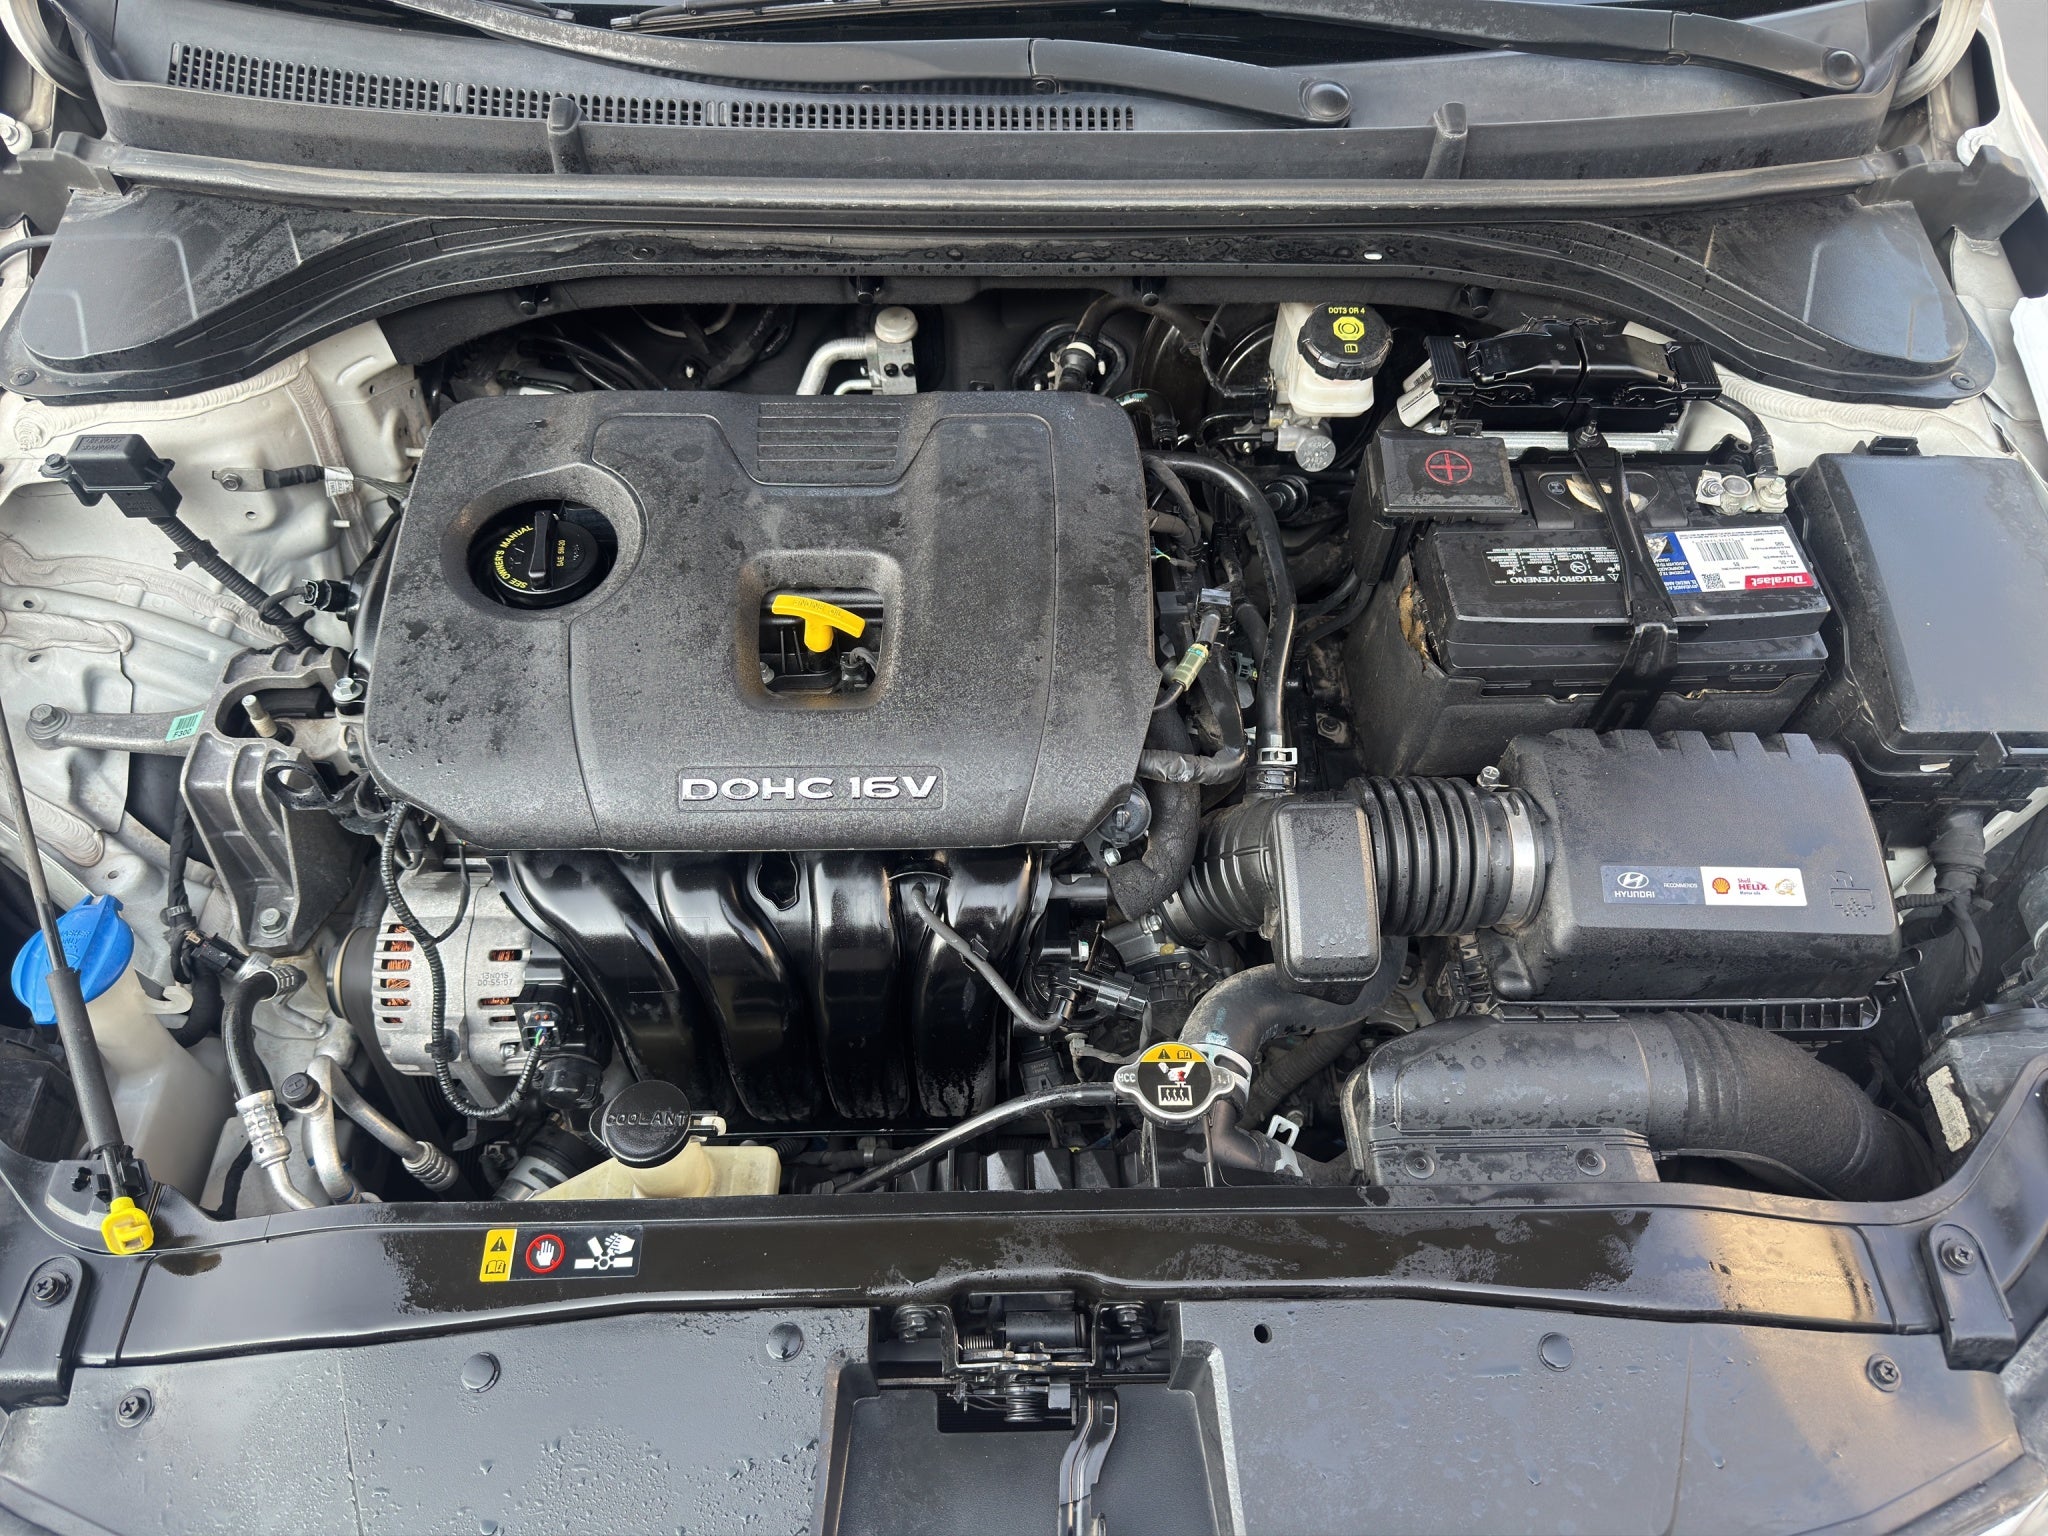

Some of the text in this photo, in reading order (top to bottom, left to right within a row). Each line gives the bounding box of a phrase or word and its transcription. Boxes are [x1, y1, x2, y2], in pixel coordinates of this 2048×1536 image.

[494, 525, 534, 589] SEE OWNER'S MANUAL
[556, 556, 564, 566] SAE
[1510, 576, 1605, 584] PELIGRO/VENENO
[1751, 576, 1807, 586] Duralast
[682, 776, 938, 801] DOHC 16V
[1738, 882, 1768, 891] HELIX
[1614, 890, 1656, 899] HYUNDAI
[1117, 1072, 1136, 1083] HCC
[606, 1108, 689, 1127] COOLANT
